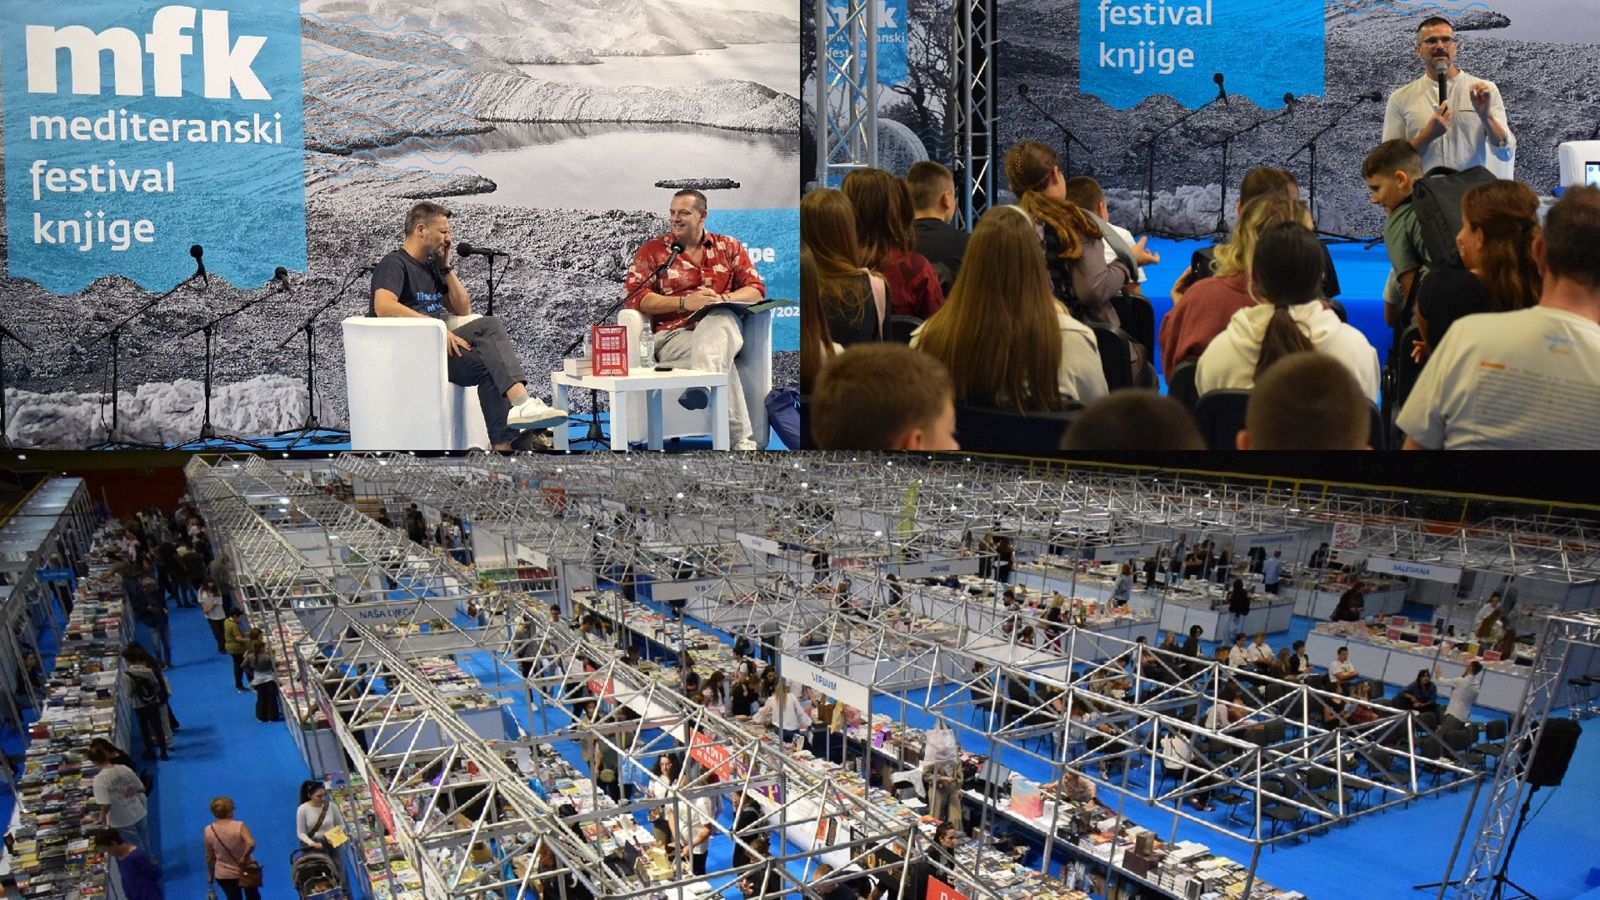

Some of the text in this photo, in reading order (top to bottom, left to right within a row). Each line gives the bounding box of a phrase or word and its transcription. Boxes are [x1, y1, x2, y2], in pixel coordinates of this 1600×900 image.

[1098, 0, 1212, 32] festival
[26, 5, 272, 100] mfk
[1099, 40, 1194, 75] knjige
[30, 108, 282, 144] mediteranski
[30, 159, 174, 200] festival
[33, 210, 155, 252] knjige
[359, 608, 386, 619] NAŠA
